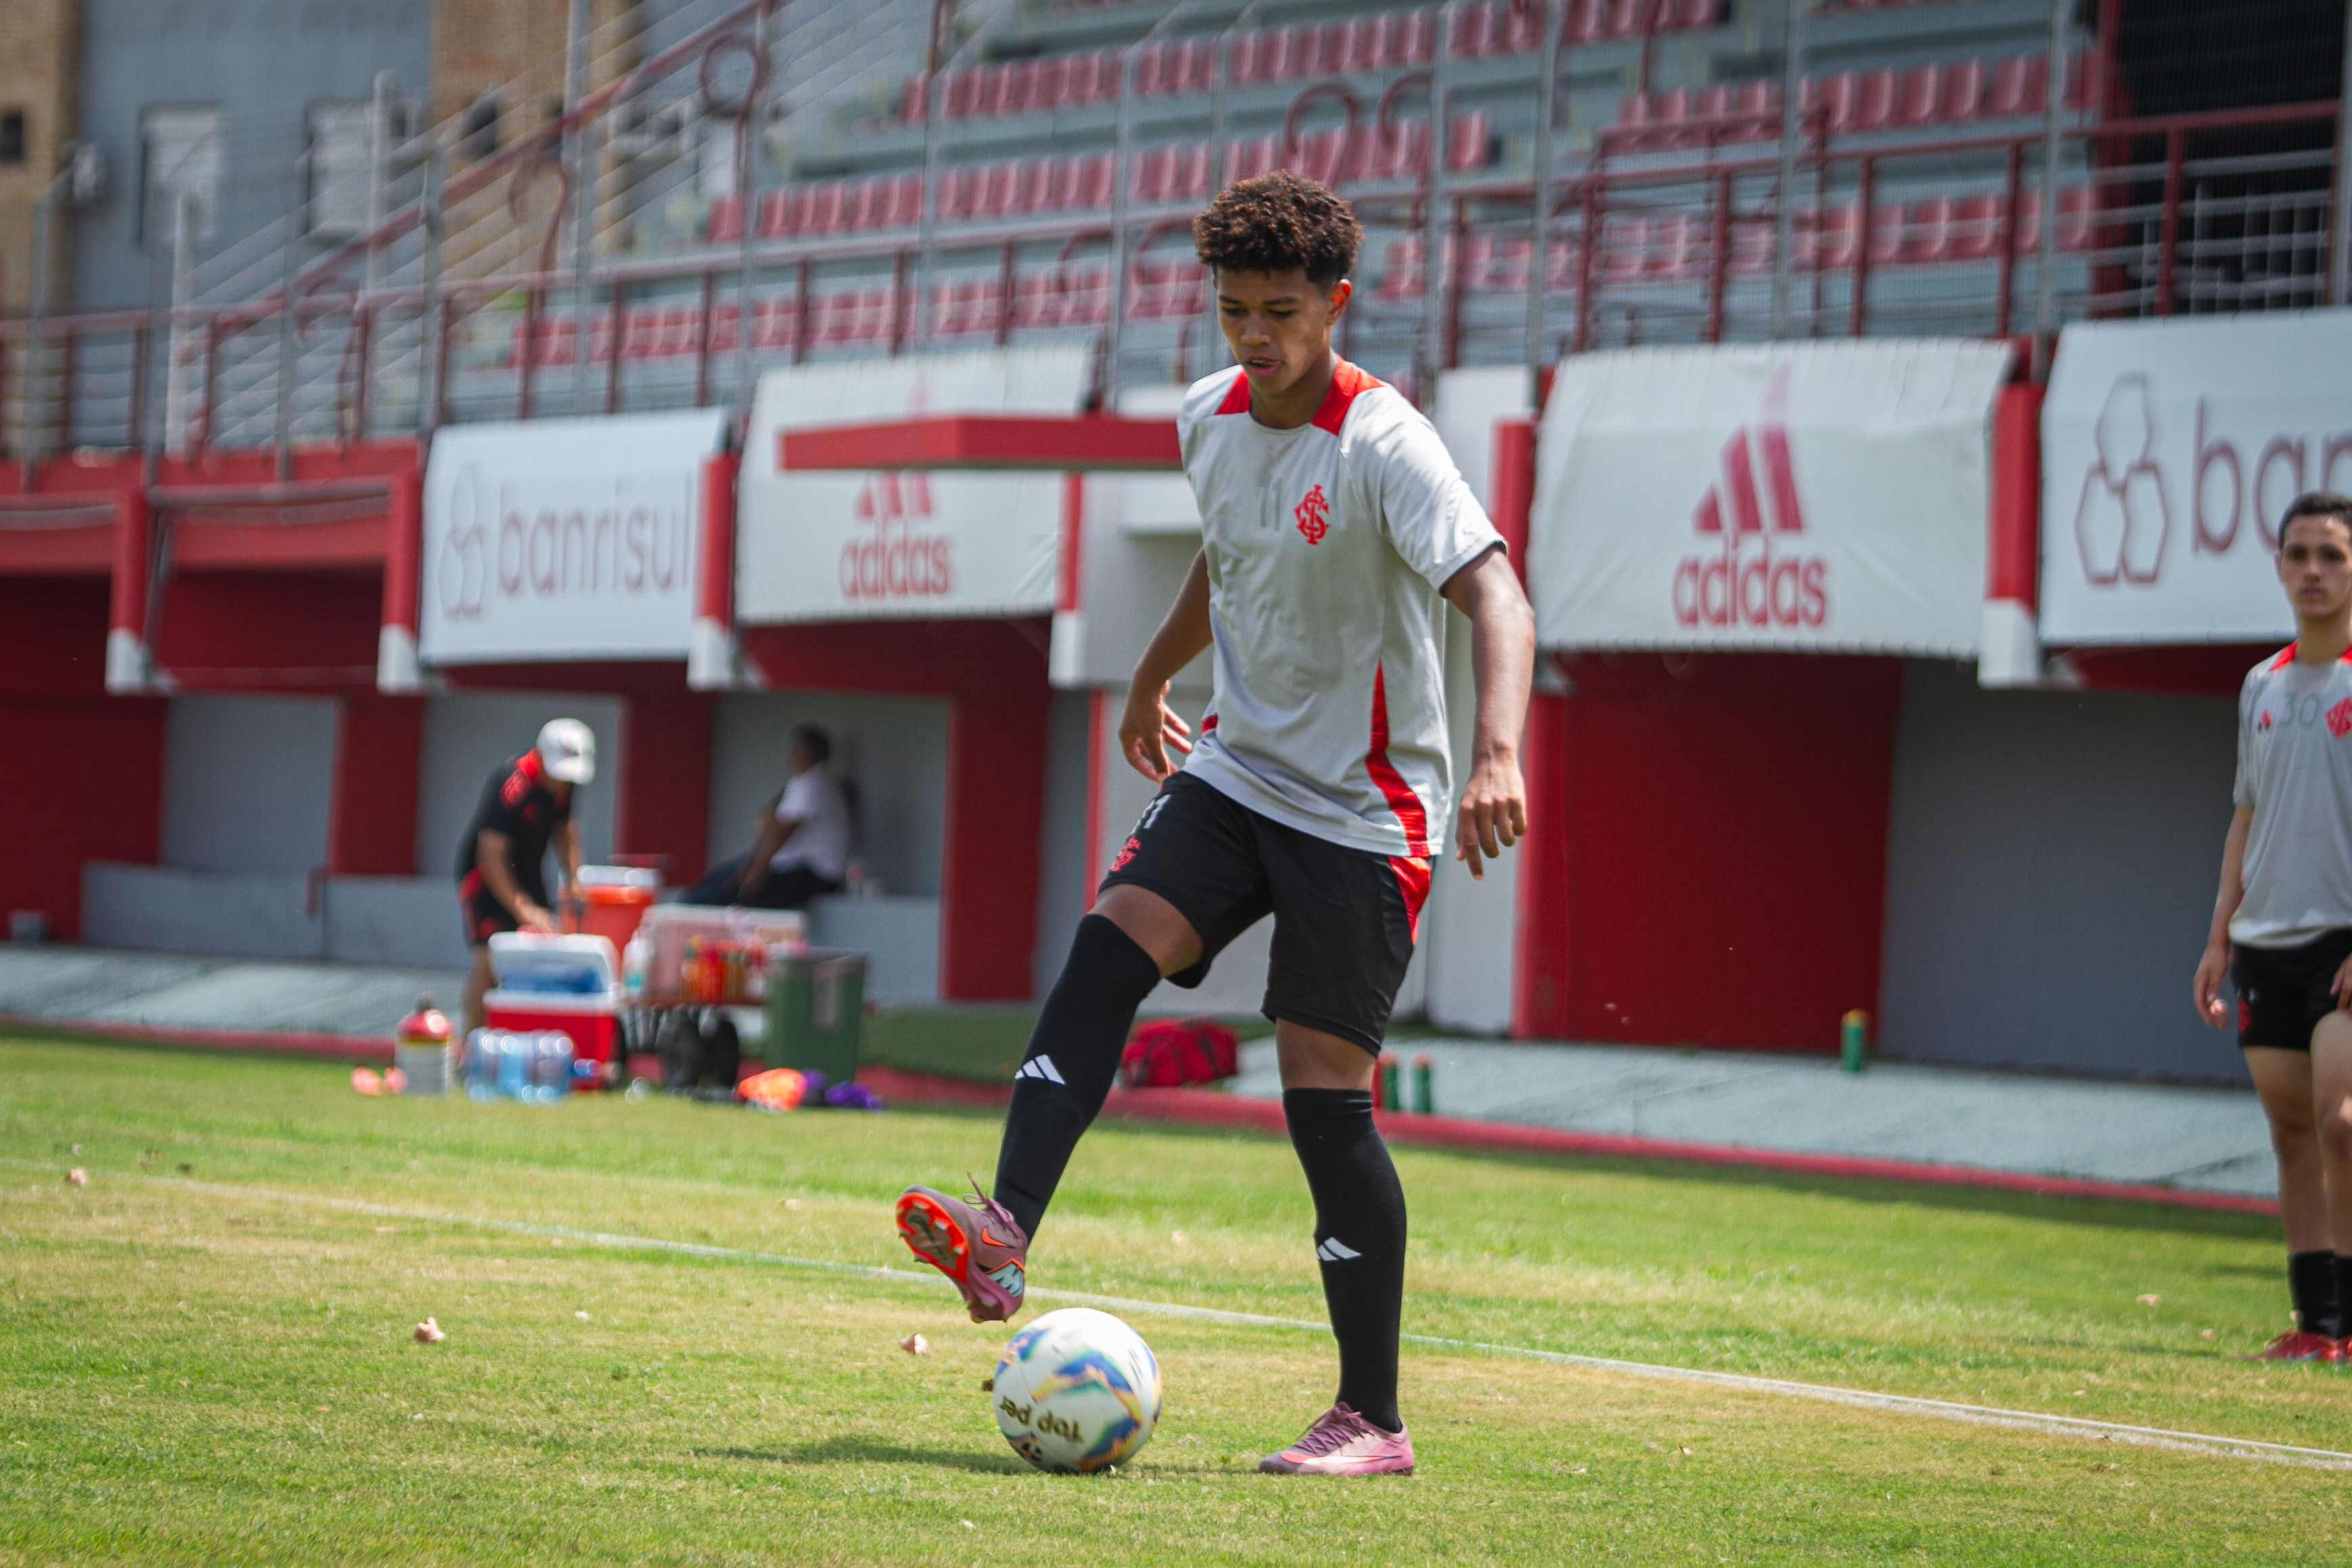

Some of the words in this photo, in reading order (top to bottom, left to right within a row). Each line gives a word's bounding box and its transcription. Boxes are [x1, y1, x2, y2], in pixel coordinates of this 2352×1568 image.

[496, 470, 693, 596] banrisul
[840, 513, 952, 599] adidas
[1672, 532, 1829, 629] adidas
